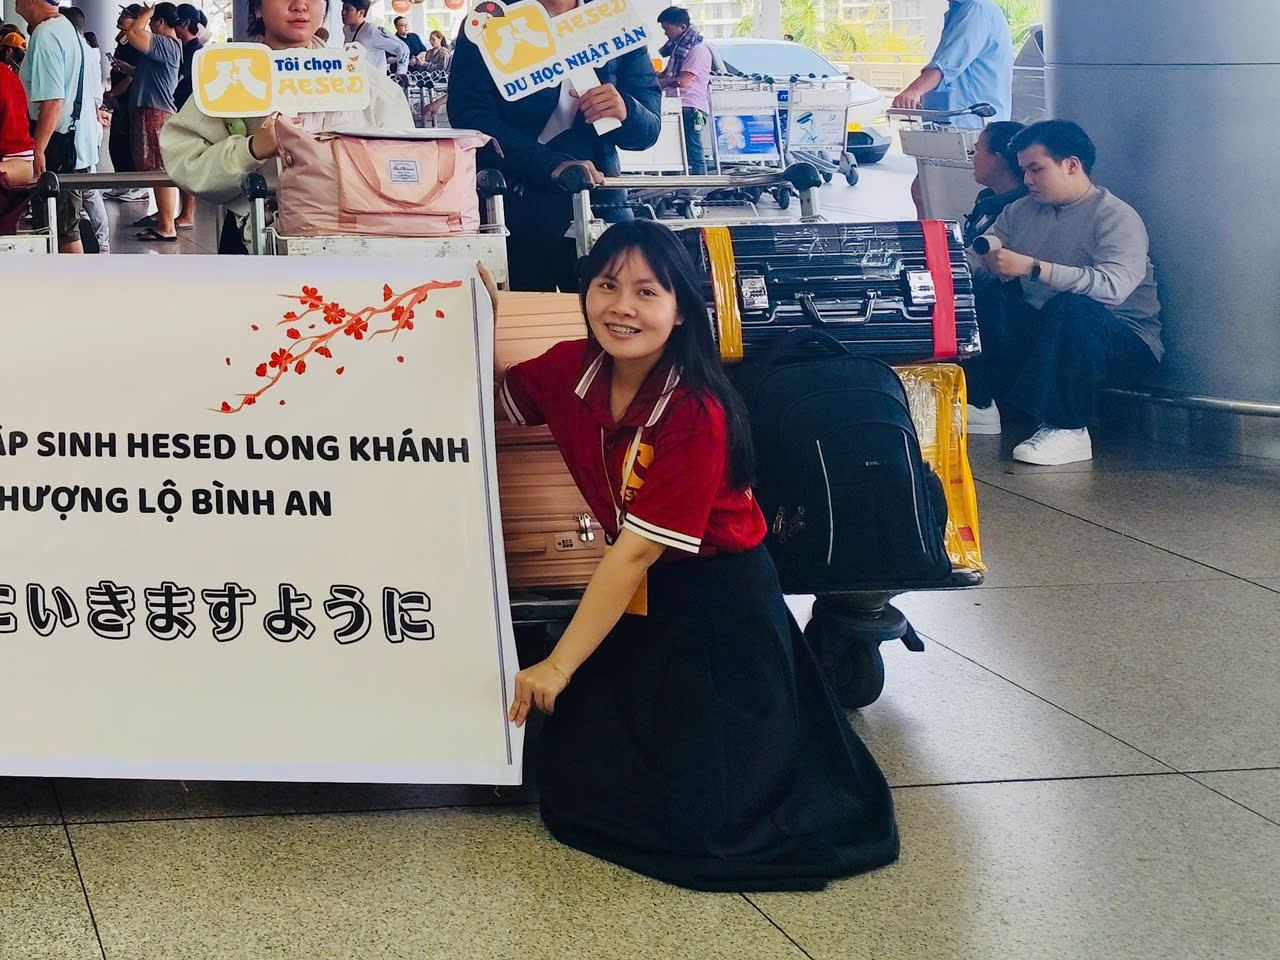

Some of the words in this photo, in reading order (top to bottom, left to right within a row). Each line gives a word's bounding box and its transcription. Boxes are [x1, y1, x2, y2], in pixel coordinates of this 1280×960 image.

[274, 57, 300, 72] Tôi
[304, 57, 342, 73] chọn
[503, 76, 528, 97] DU
[530, 62, 564, 86] HỌC
[564, 42, 610, 71] NHẬT
[613, 26, 647, 50] BẢN
[37, 431, 117, 458] SINH
[127, 432, 237, 460] HESED
[246, 434, 340, 462] LONG
[349, 428, 470, 463] KHÁNH
[138, 479, 182, 523] LỘ
[192, 480, 275, 516] BÌNH
[284, 490, 333, 517] AN
